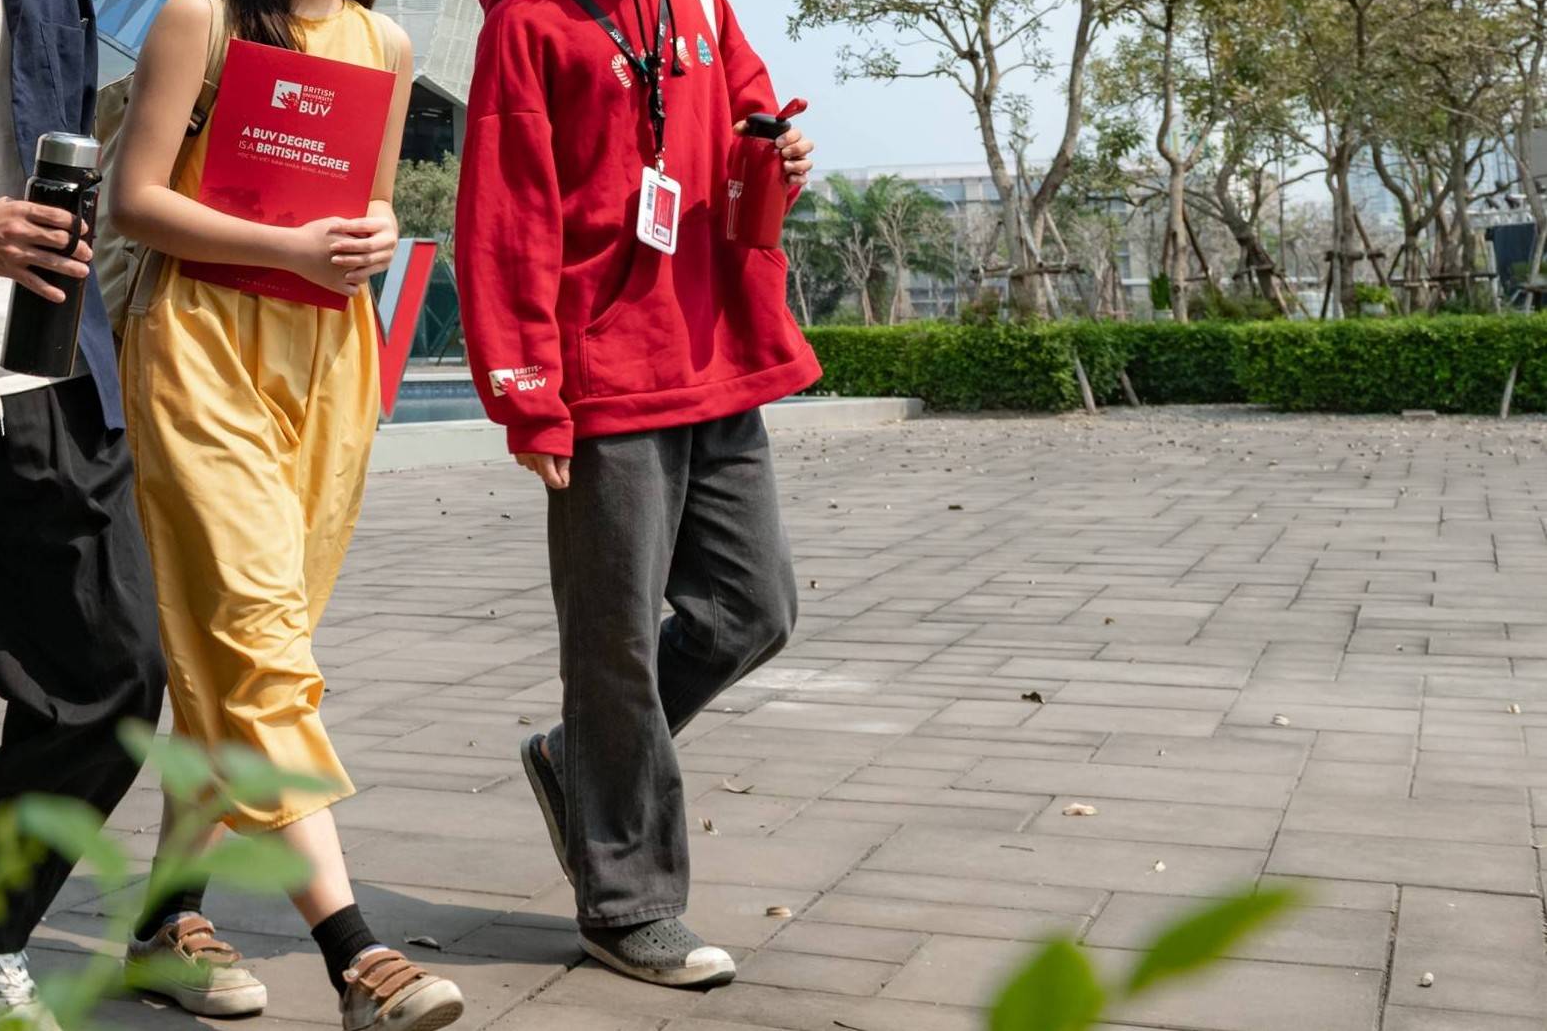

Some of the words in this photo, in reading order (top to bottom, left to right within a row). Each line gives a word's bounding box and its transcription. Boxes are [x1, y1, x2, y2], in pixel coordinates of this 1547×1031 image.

[303, 85, 335, 98] BRITISH
[299, 100, 331, 117] BUV
[241, 126, 251, 137] A
[252, 127, 278, 141] BUV
[278, 133, 326, 152] DEGREE
[238, 140, 247, 150] IS
[247, 142, 255, 151] A
[256, 142, 301, 161] BRITISH
[302, 152, 350, 172] DEGREE
[517, 378, 546, 391] BUV
